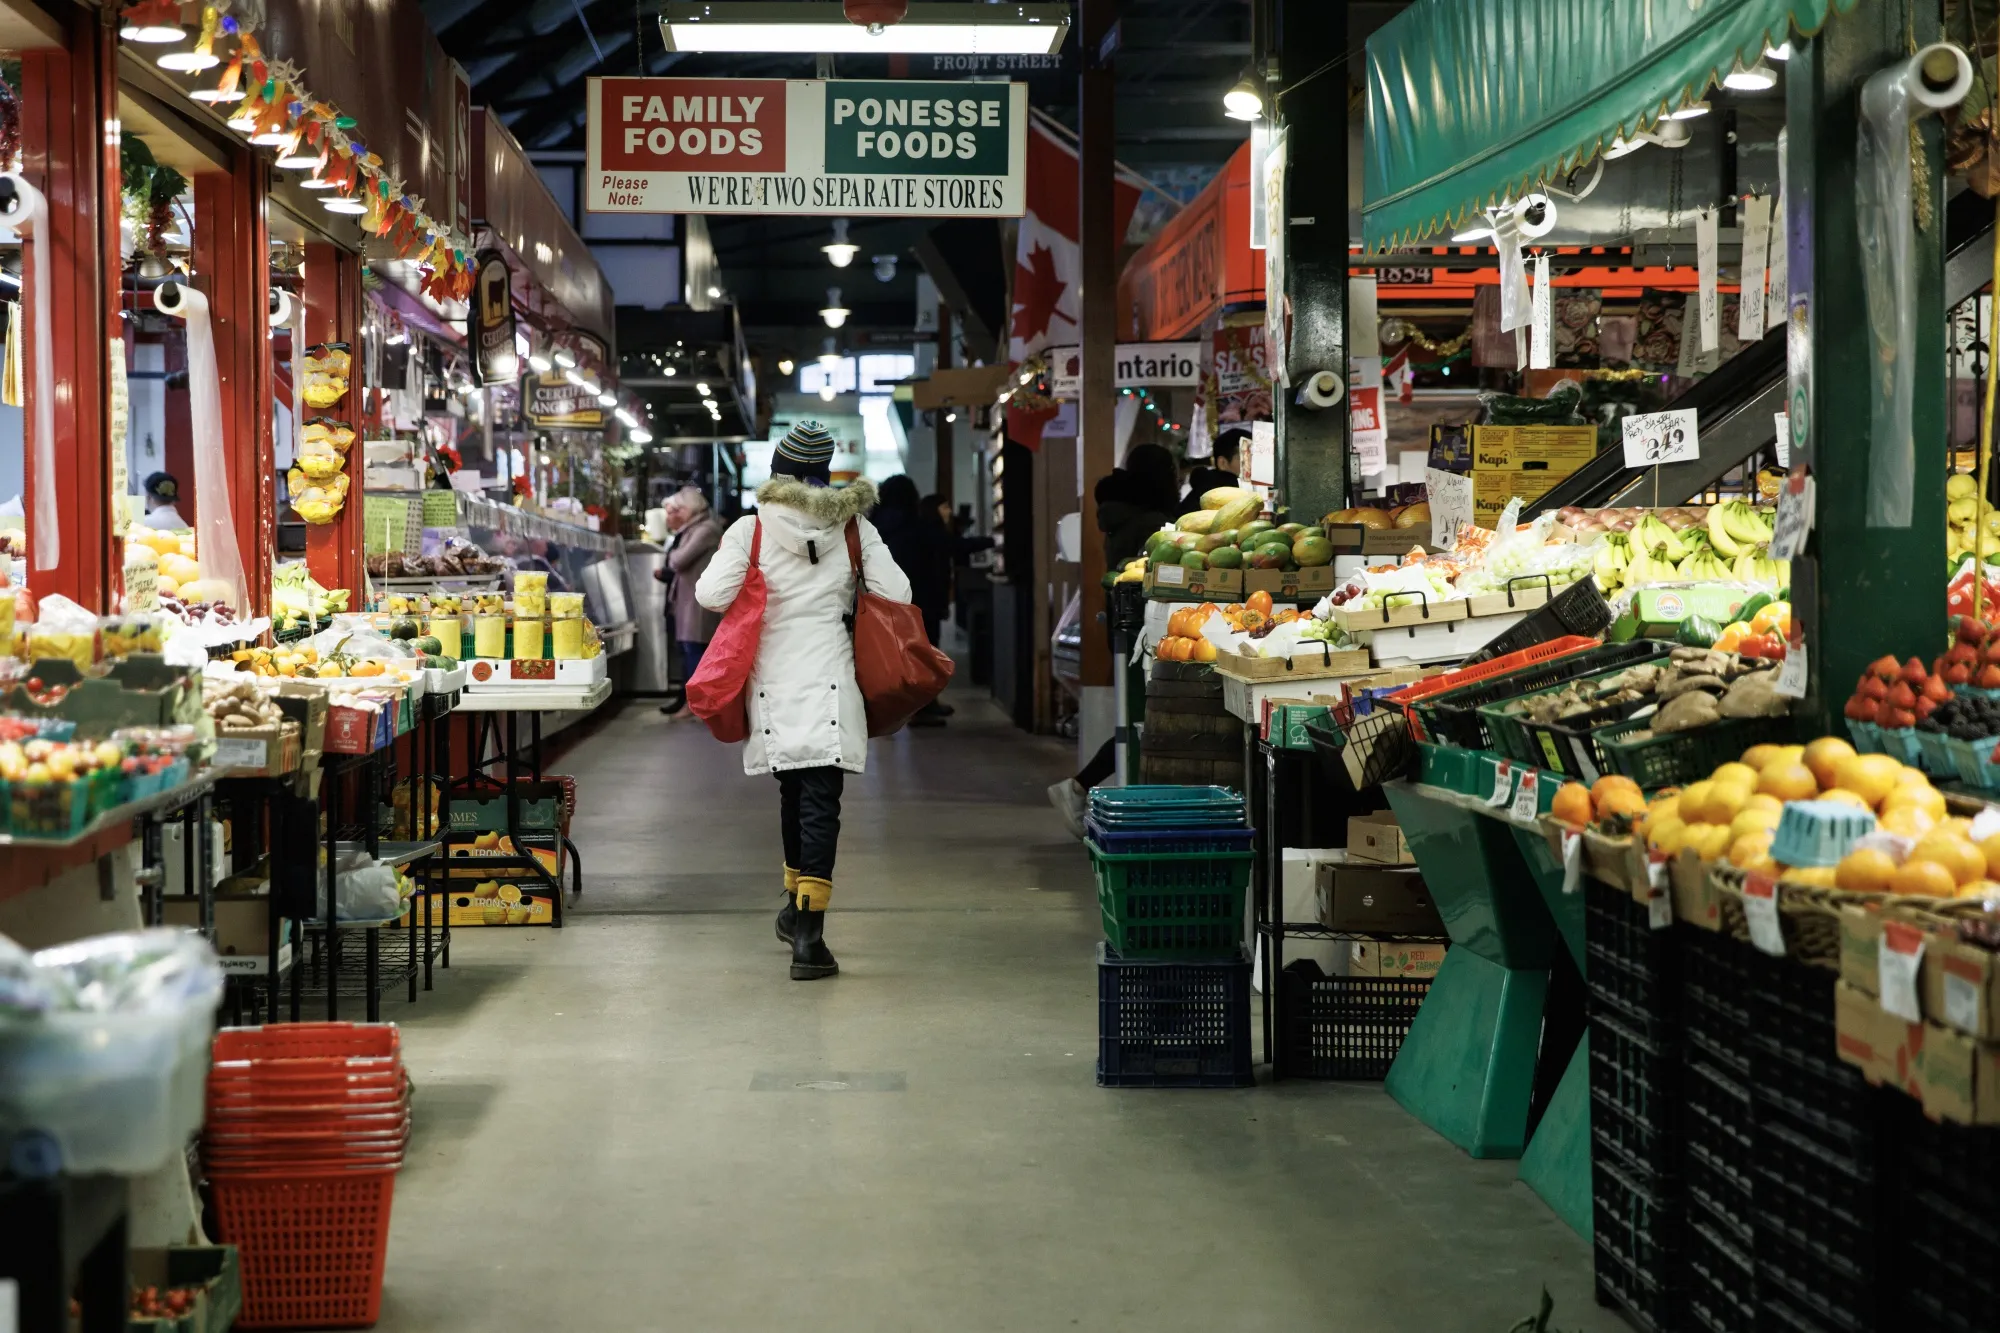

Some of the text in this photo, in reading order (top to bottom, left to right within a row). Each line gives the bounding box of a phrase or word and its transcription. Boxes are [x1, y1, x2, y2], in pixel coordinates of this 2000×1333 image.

[933, 54, 1063, 70] FRONT STREET
[623, 96, 764, 123] FAMILY
[833, 99, 1000, 127] PONESSE
[624, 127, 763, 156] FOODS
[857, 131, 977, 159] FOODS
[602, 175, 649, 190] Please
[688, 176, 1003, 209] WE'RE TWO SEPARATE STORES
[607, 191, 643, 206] Note:
[1377, 267, 1431, 283] 1854
[1118, 353, 1194, 379] ntario
[1479, 453, 1509, 467] Kapi
